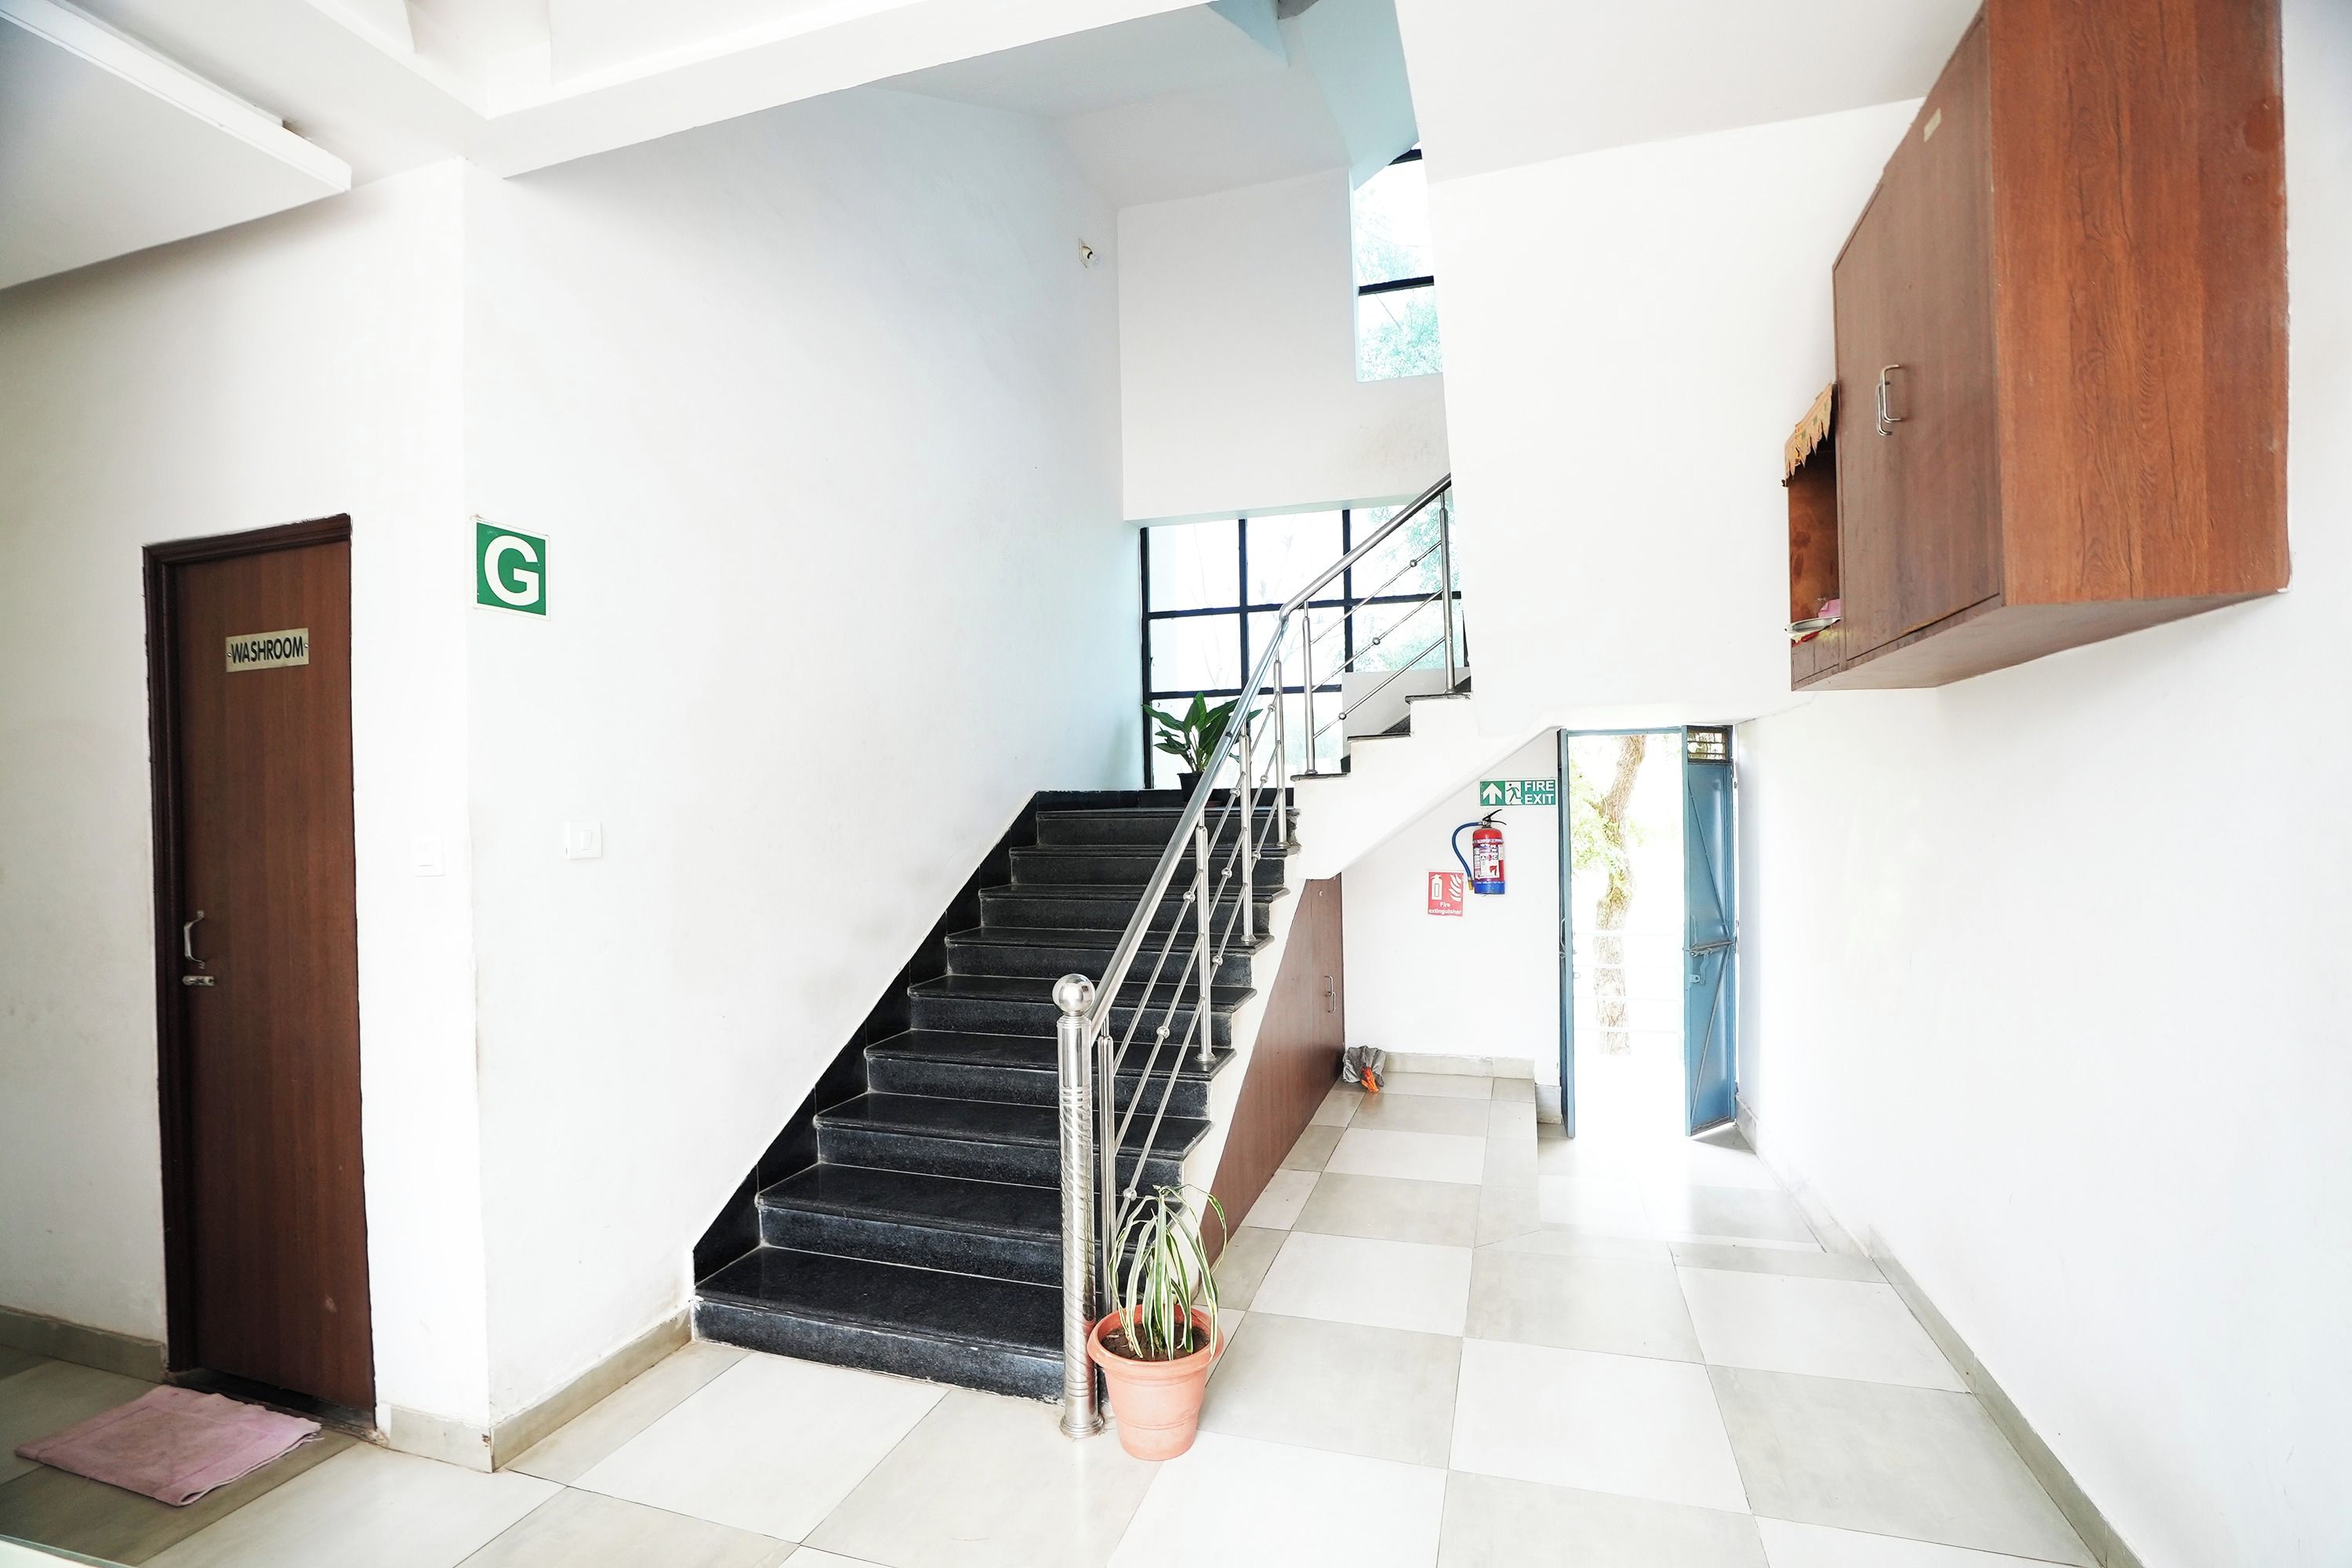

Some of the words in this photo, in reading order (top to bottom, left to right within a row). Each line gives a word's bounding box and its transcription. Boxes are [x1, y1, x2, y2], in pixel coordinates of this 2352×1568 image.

[484, 535, 540, 607] G
[230, 635, 304, 664] WASHROOM
[1524, 781, 1555, 792] FIRE
[1524, 793, 1555, 804] EXIT
